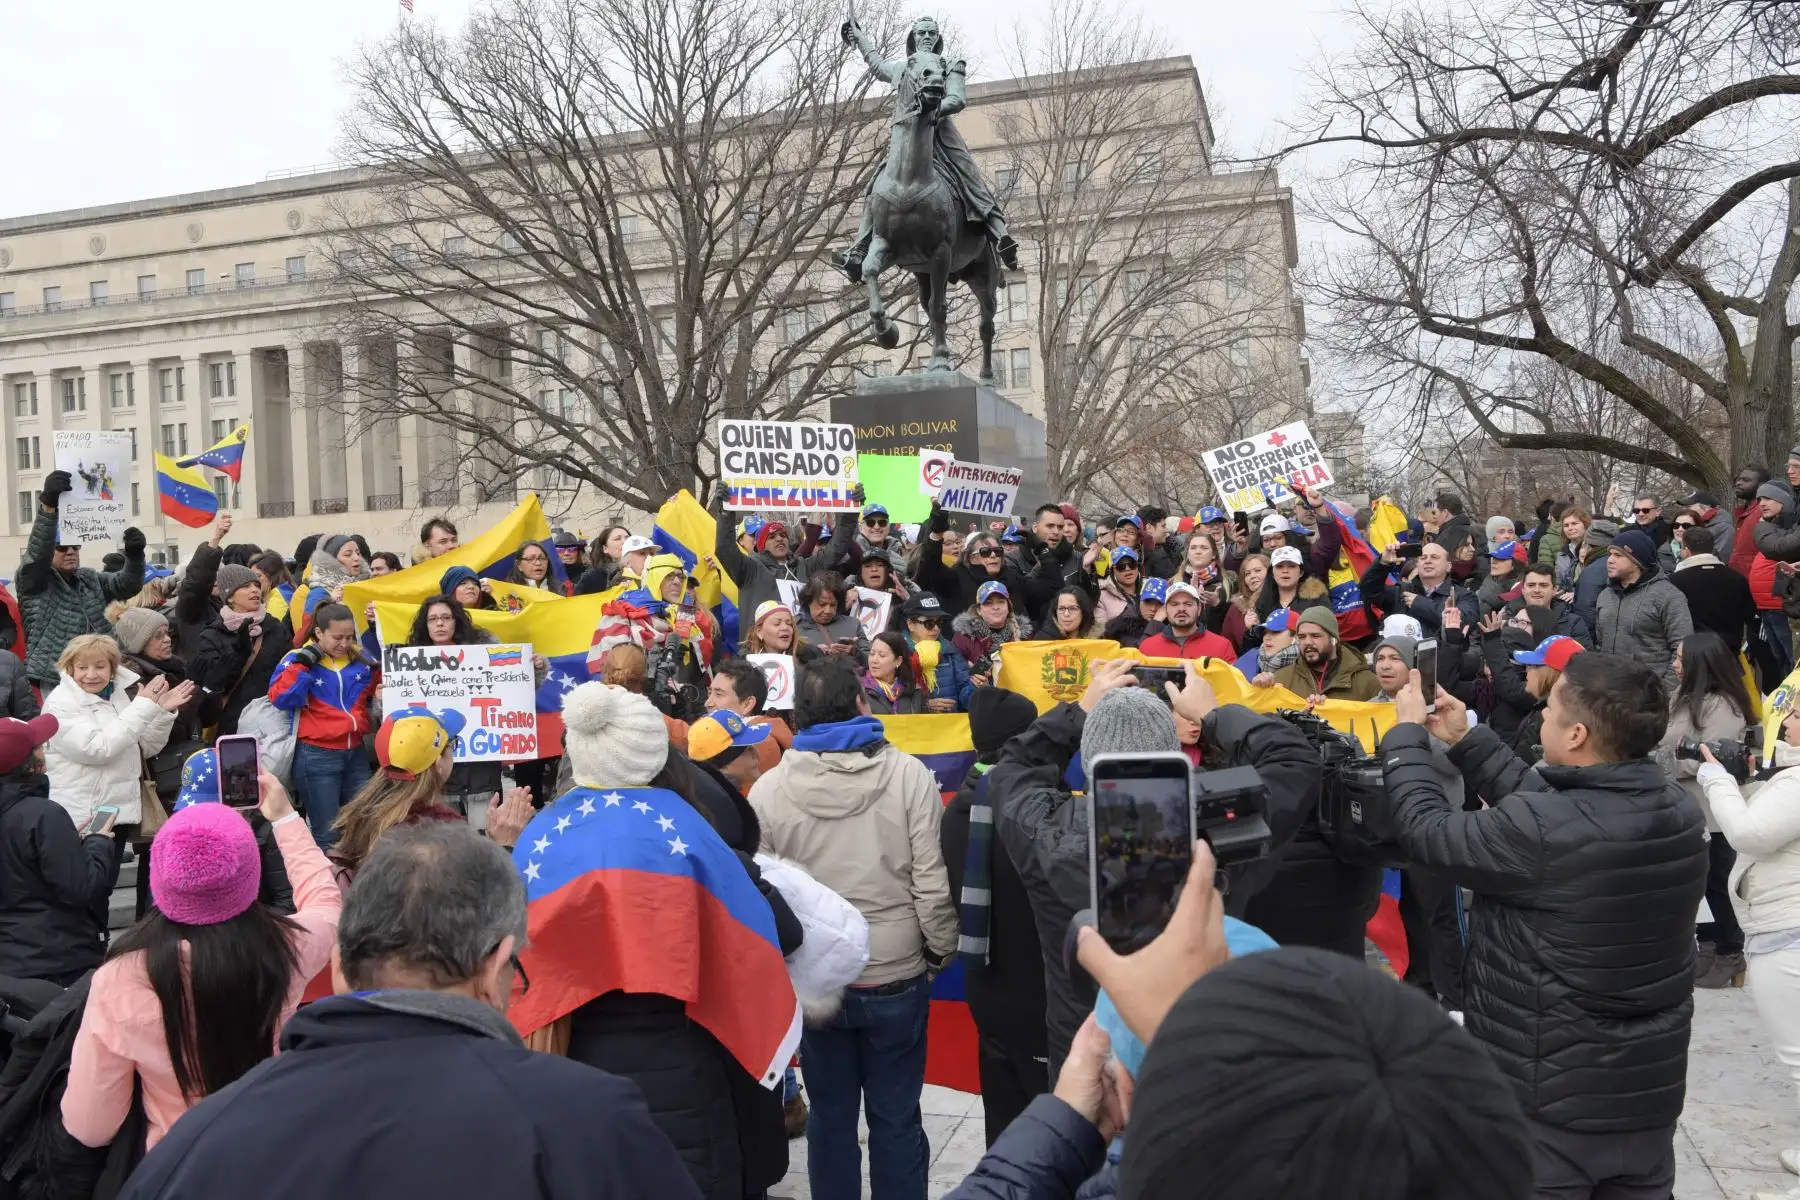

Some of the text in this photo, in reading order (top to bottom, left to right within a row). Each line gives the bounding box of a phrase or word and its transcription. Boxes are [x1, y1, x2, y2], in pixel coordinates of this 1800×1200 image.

[901, 419, 958, 436] BOLIVAR
[1214, 441, 1256, 465] NO
[1222, 453, 1320, 494] CUBANA EN
[77, 533, 111, 543] FUERA
[416, 674, 427, 686] te
[481, 670, 531, 683] Presidente
[400, 688, 414, 697] de
[469, 728, 536, 756] GUAIDO
